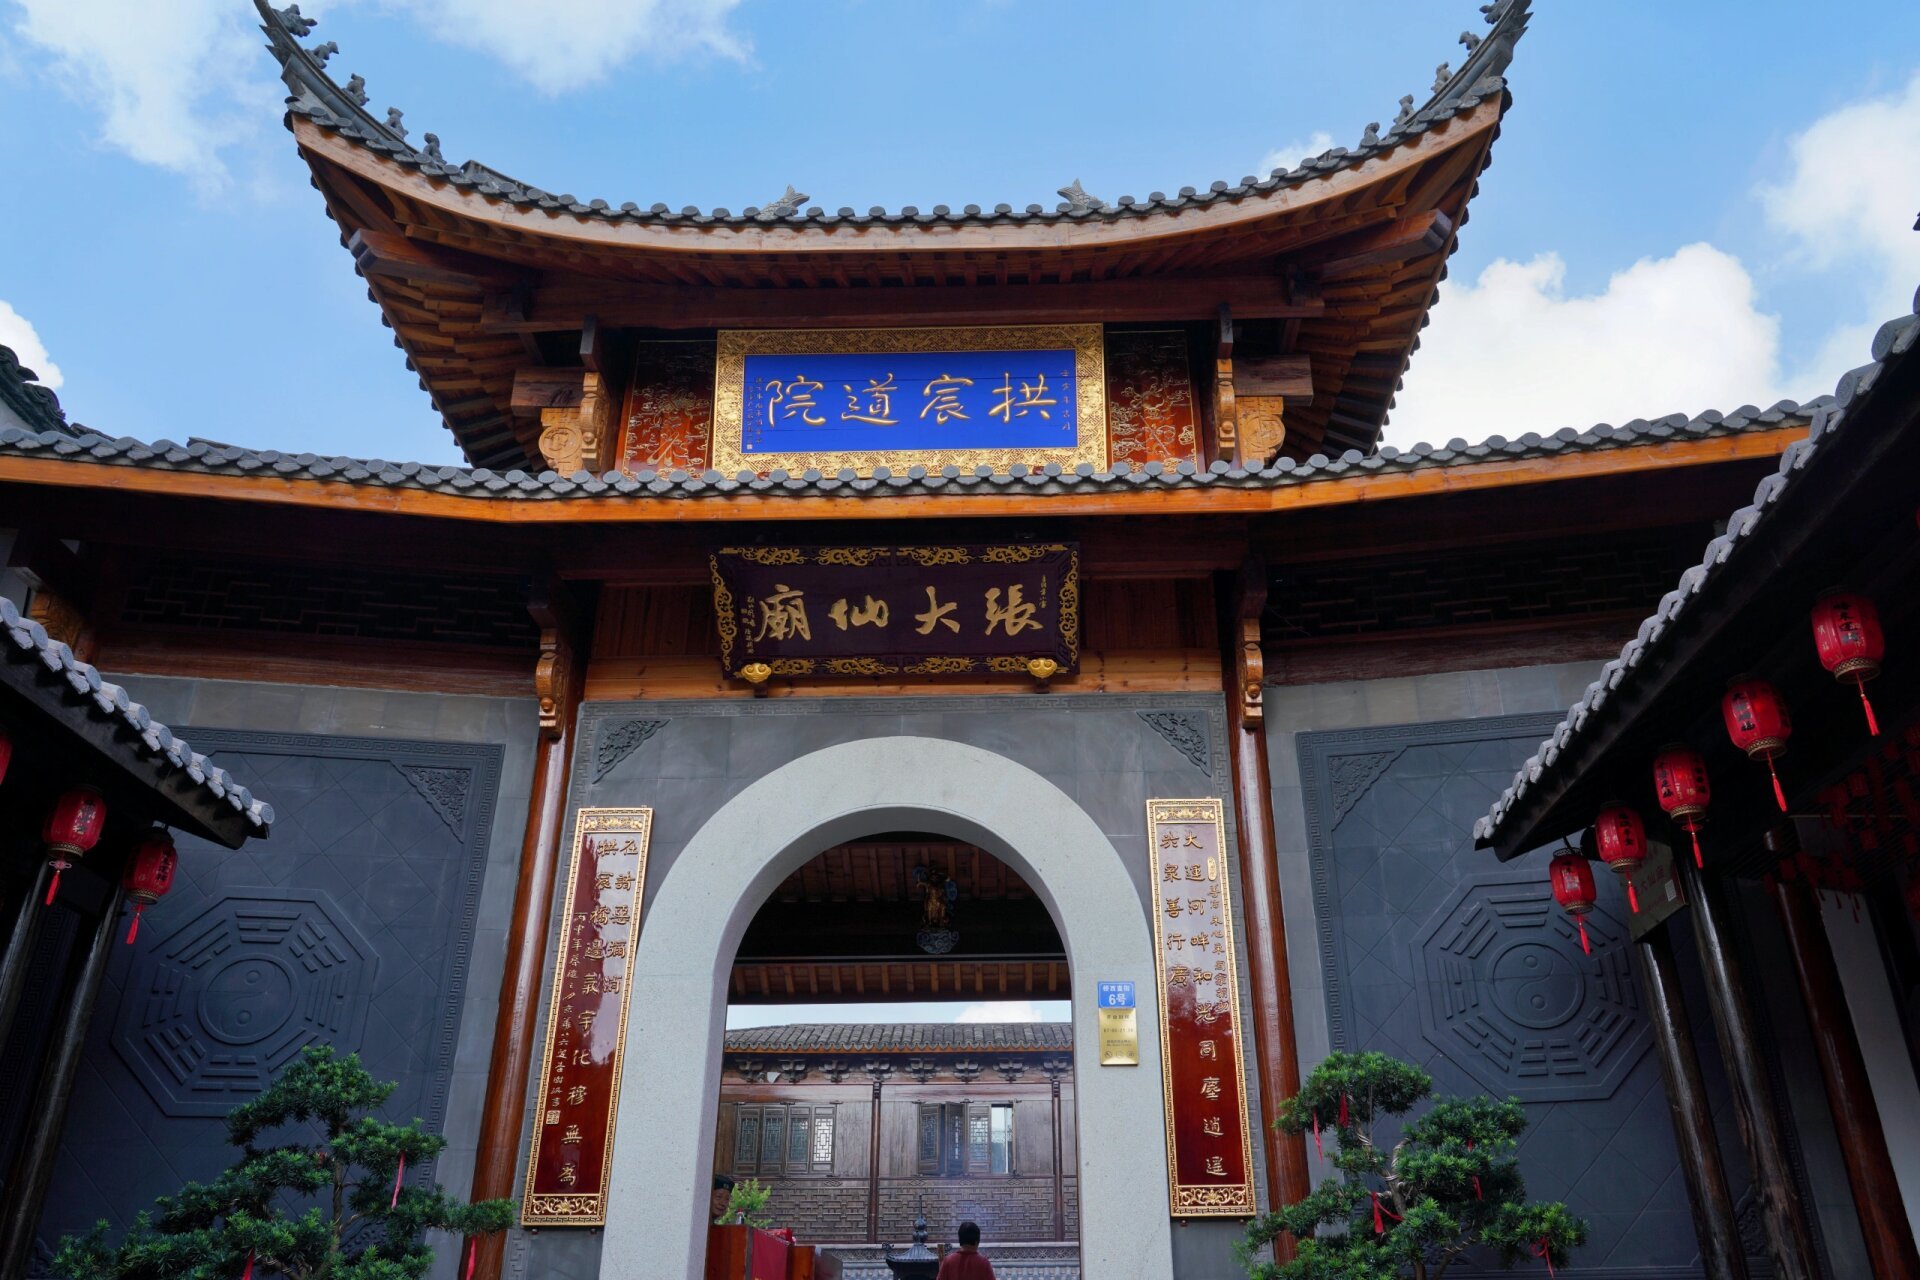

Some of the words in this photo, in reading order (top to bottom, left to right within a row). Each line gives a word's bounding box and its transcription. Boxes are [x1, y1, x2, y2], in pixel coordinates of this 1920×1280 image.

[765, 372, 1057, 427] 拱宸道院
[1108, 993, 1126, 1006] 6号
